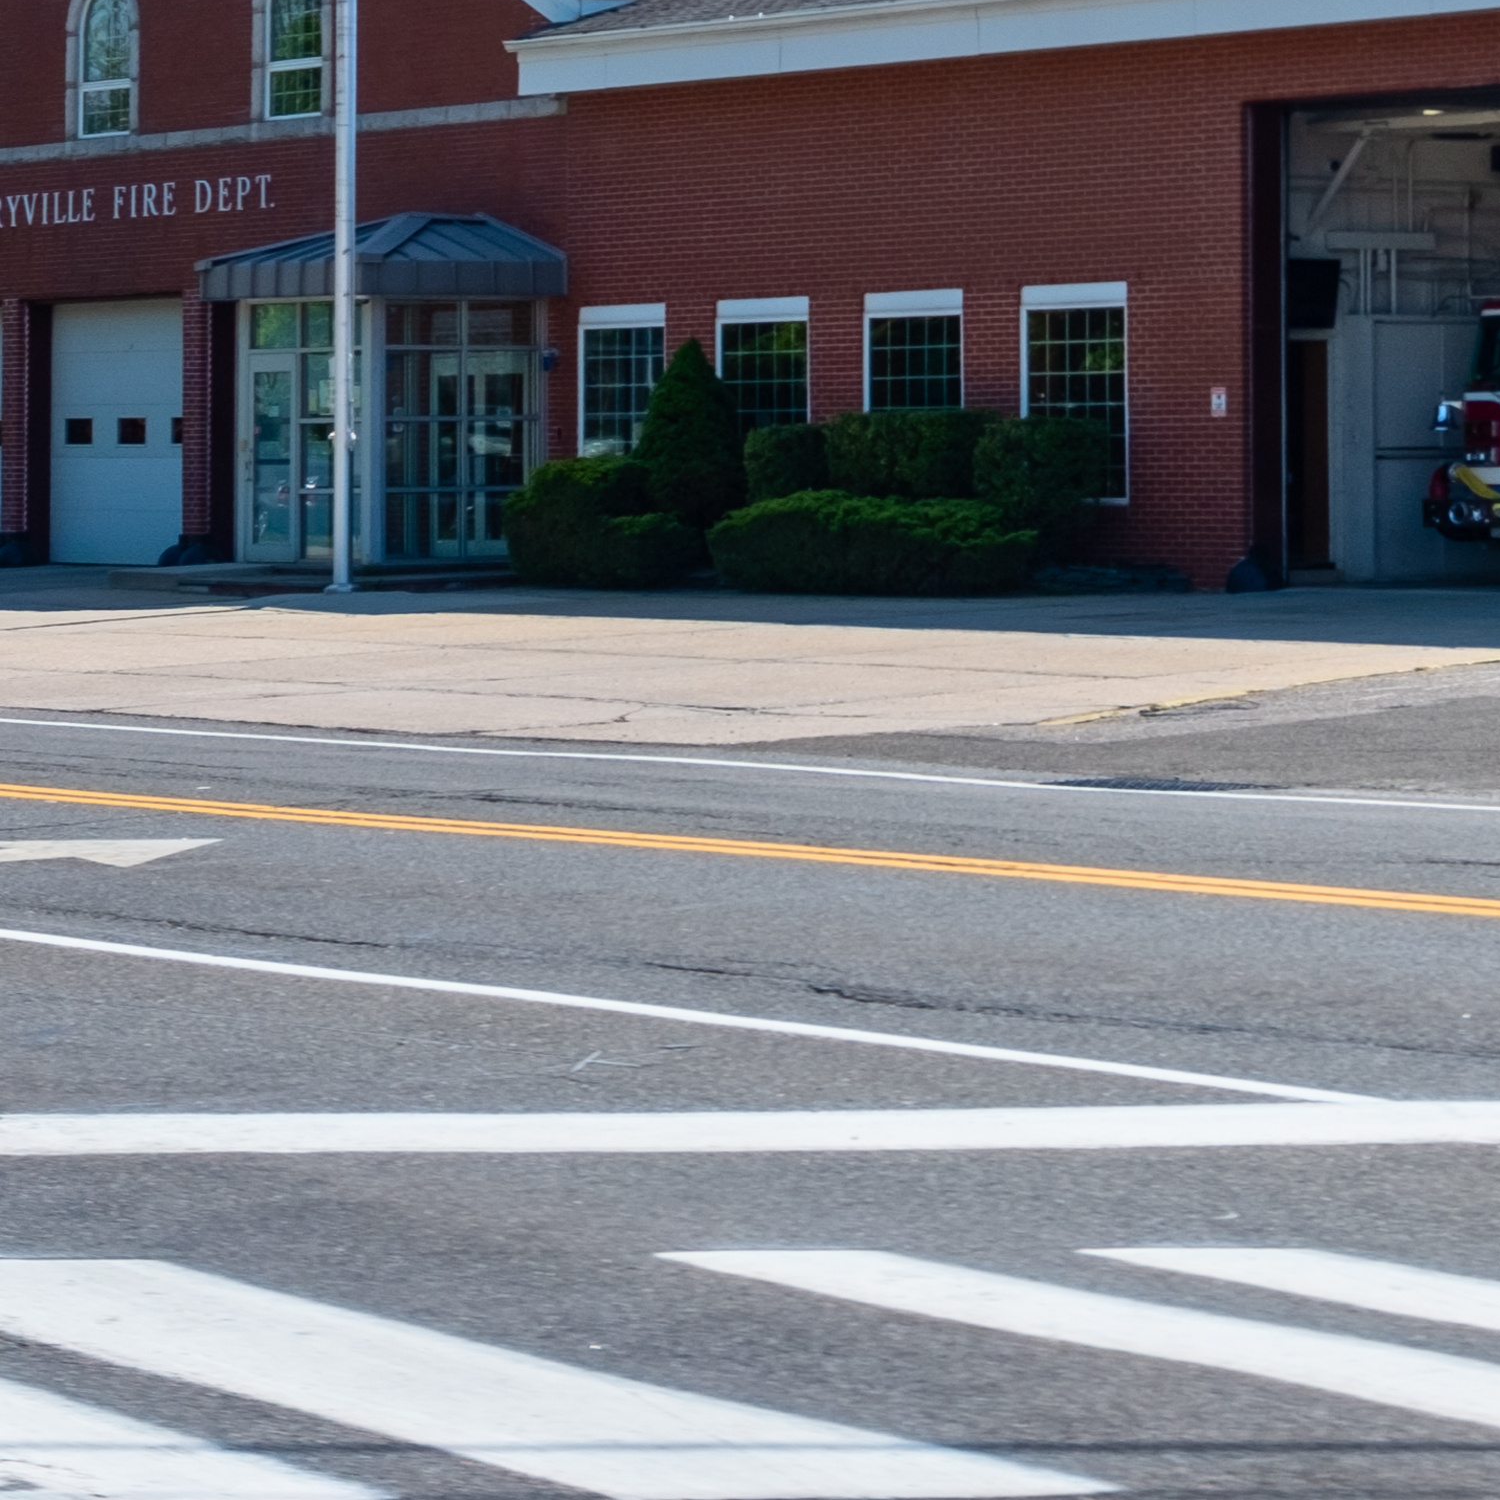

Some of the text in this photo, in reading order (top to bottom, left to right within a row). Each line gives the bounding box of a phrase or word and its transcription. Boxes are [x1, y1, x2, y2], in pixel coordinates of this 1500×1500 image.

[0, 174, 276, 228] YVILLE FIRE DEPT.
